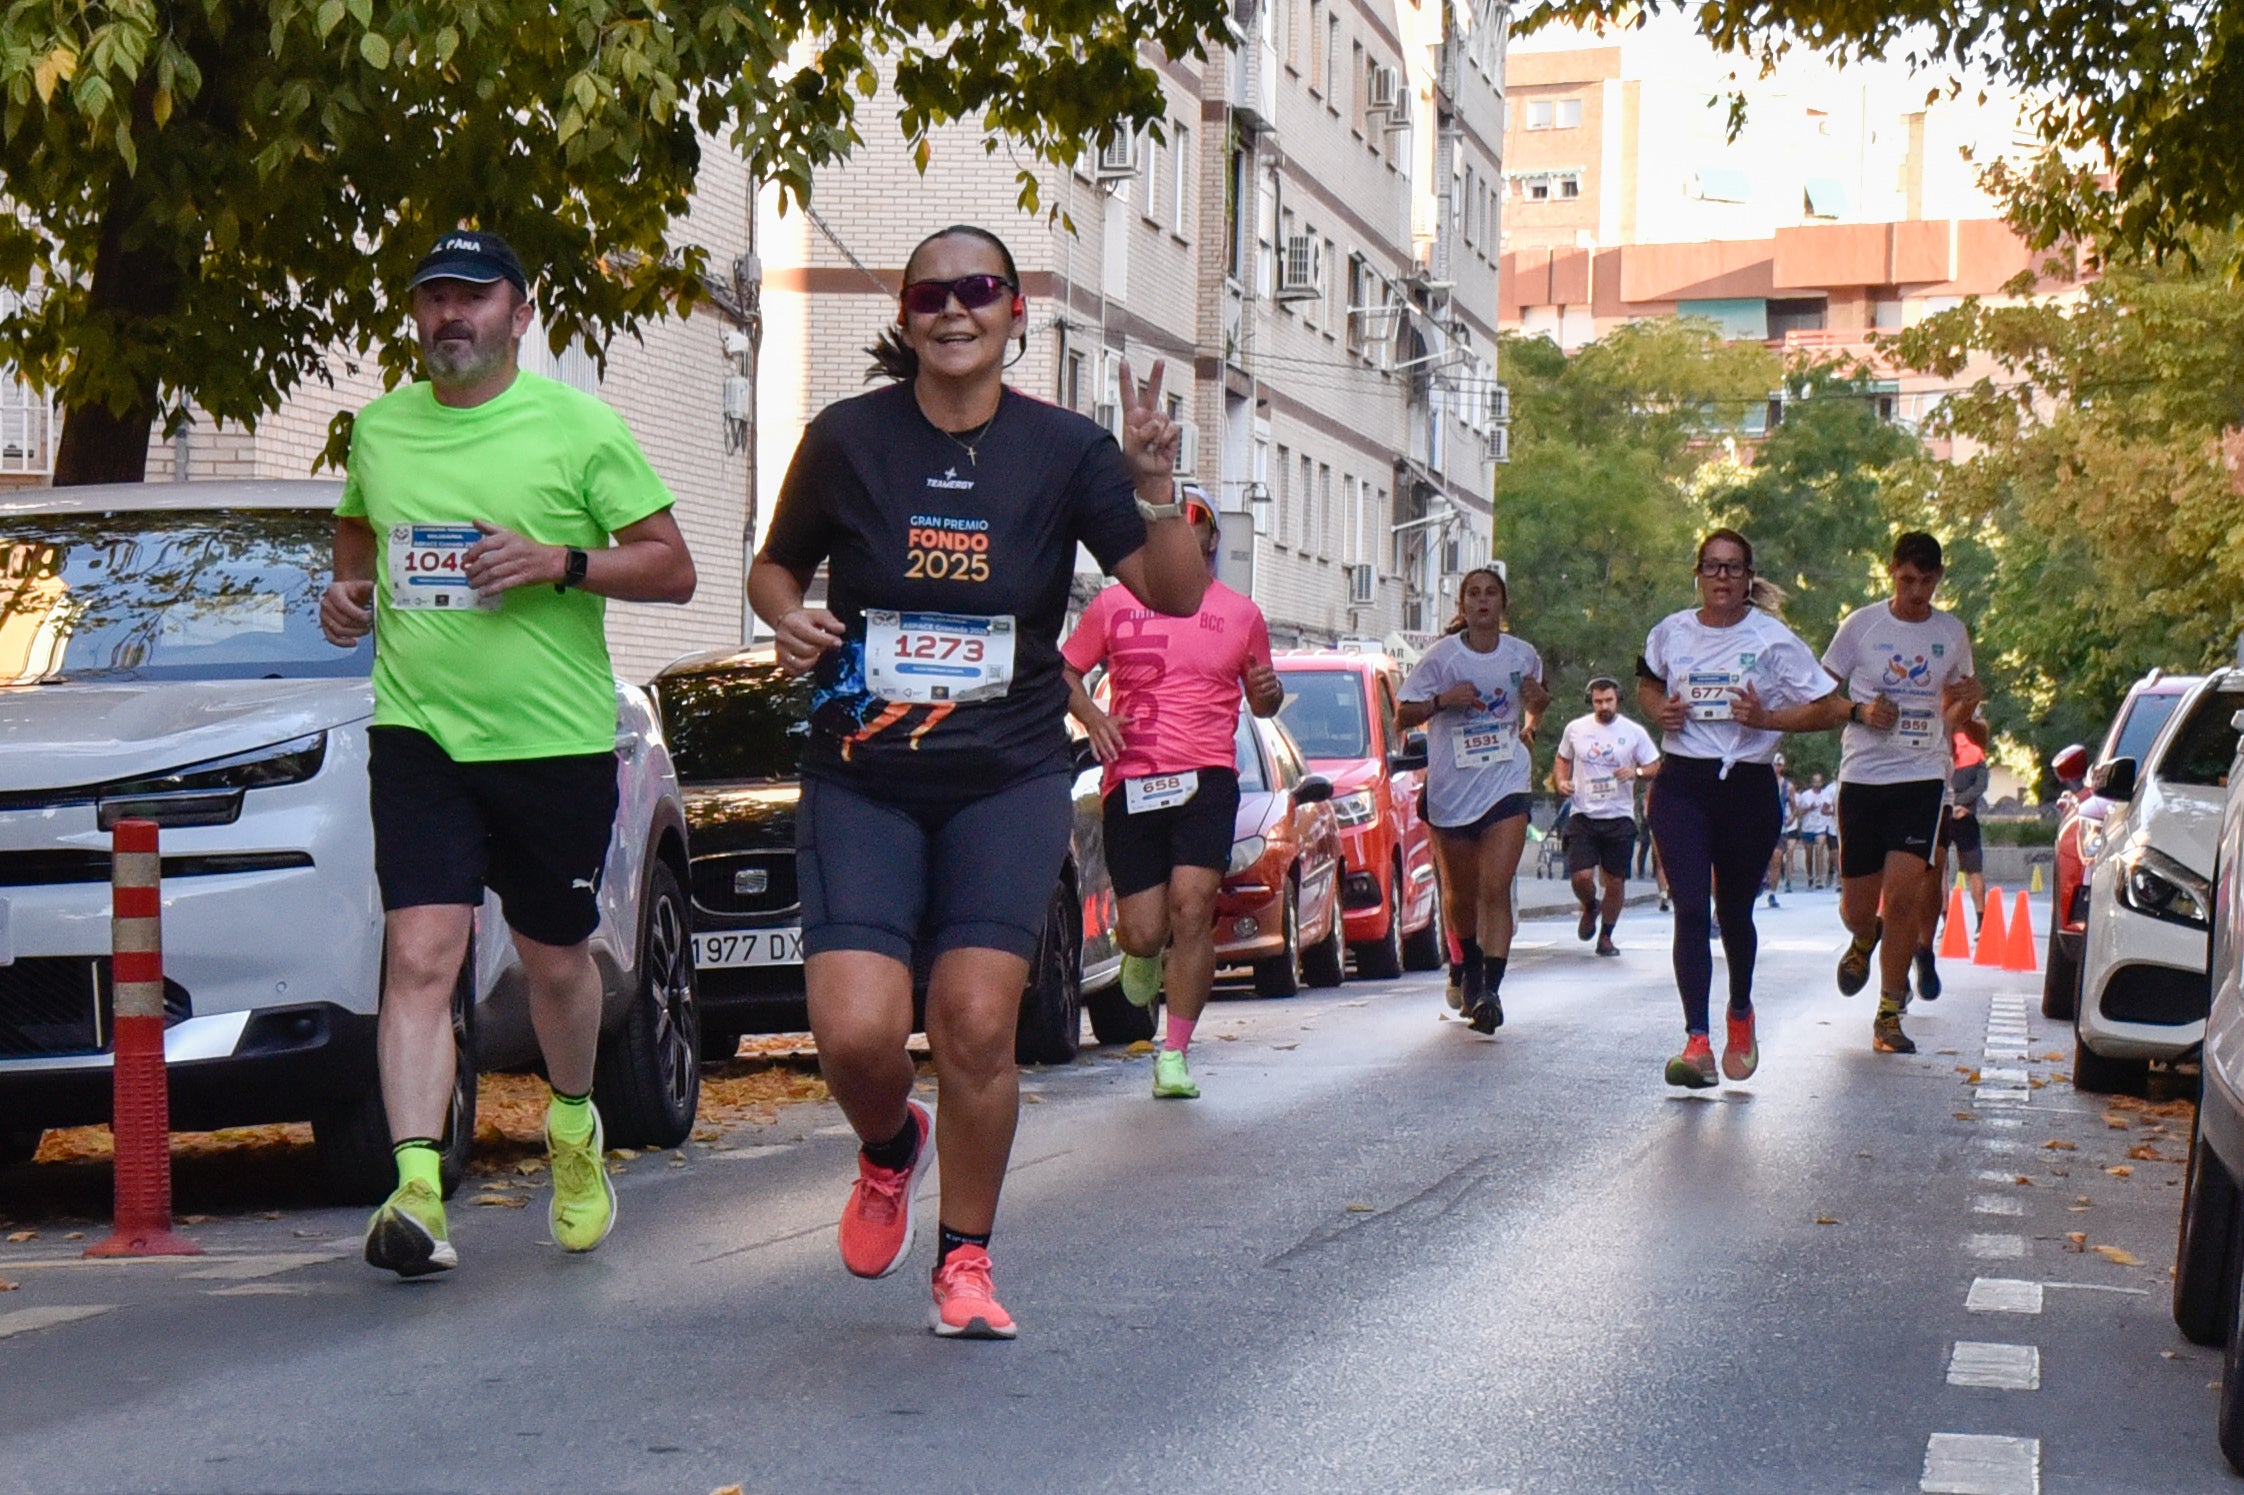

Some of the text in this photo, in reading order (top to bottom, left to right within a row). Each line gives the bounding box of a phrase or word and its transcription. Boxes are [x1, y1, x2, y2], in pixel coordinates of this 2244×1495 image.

[446, 238, 481, 252] PANA
[910, 515, 989, 531] GRAN PREMIO
[908, 528, 989, 552] FONDO
[903, 549, 990, 582] 2025
[935, 624, 969, 634] Granada
[1199, 612, 1226, 633] BCC
[894, 635, 985, 662] 1273
[1691, 687, 1724, 698] 677
[1901, 720, 1928, 730] 859
[1143, 777, 1180, 793] 658
[692, 935, 758, 964] 1977
